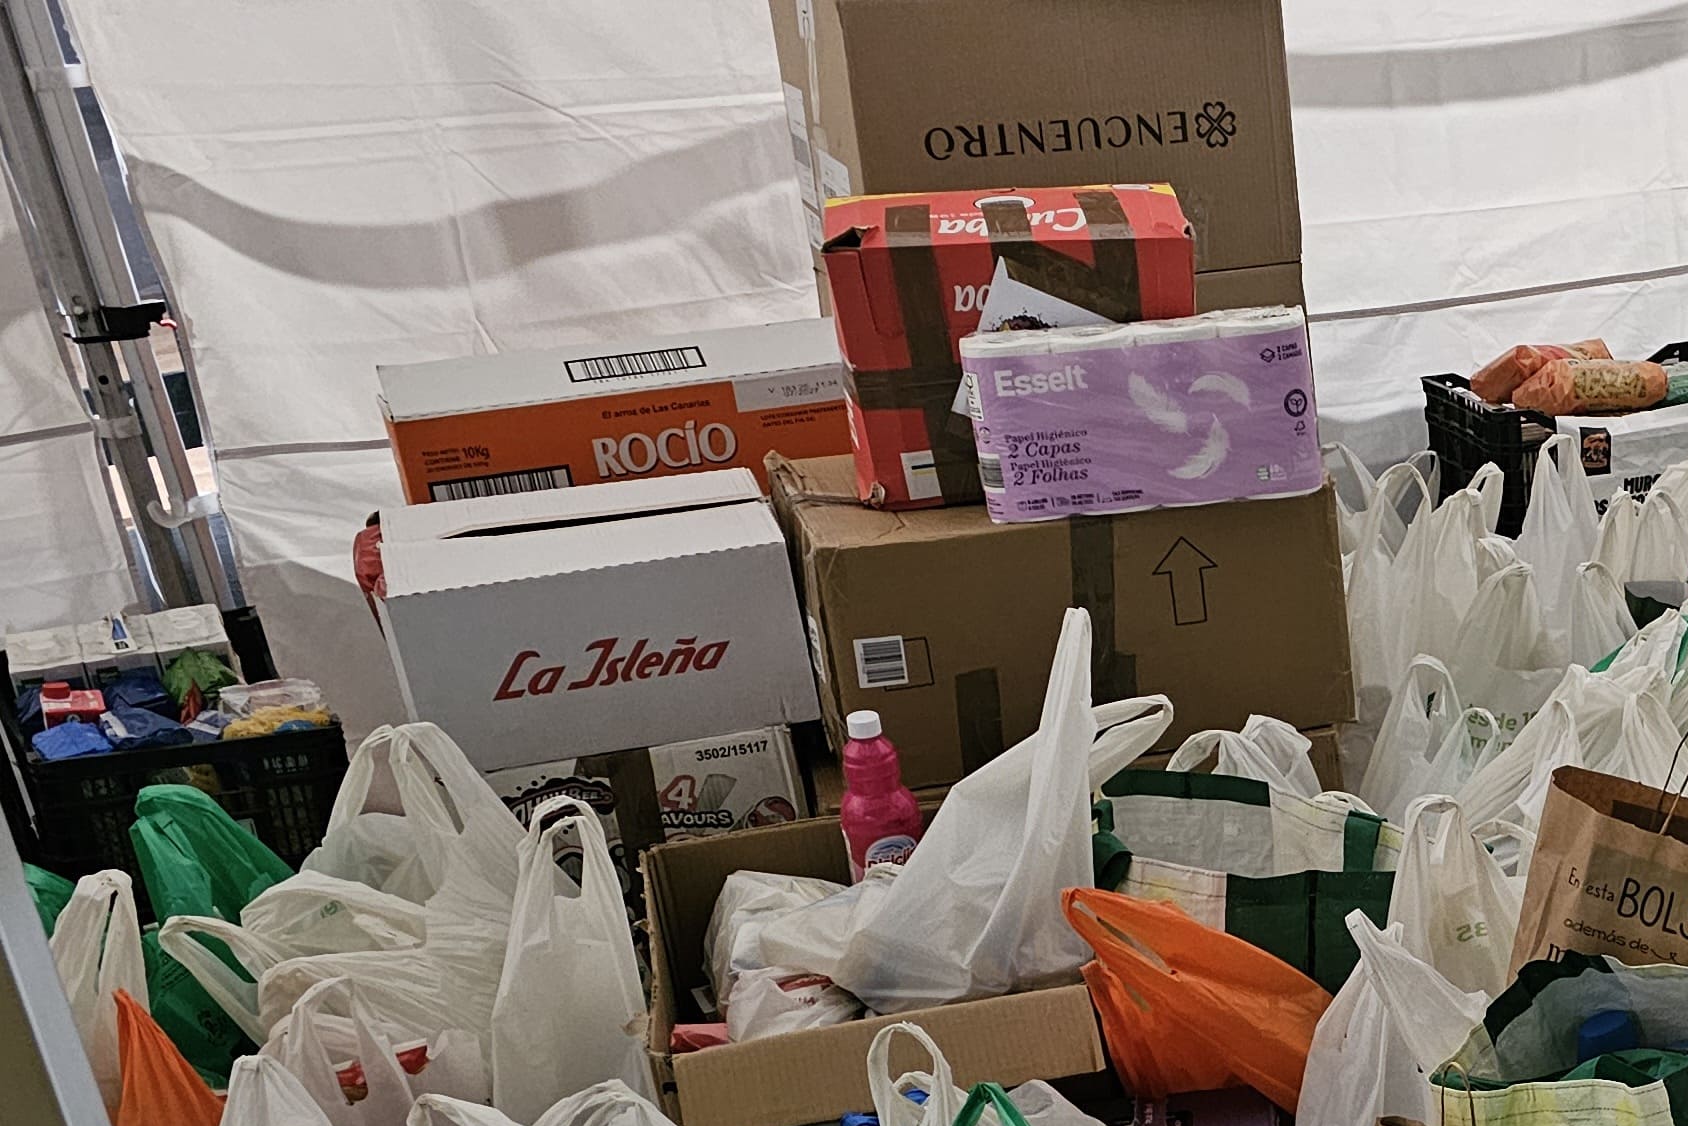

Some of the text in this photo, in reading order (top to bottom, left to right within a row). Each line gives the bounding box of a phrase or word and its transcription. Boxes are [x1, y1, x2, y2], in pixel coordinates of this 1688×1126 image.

[925, 111, 1189, 160] ENCUENTRO
[994, 365, 1088, 397] Esselt
[602, 399, 711, 420] El arroz de Las Canarias
[592, 420, 737, 478] ROCÍO
[1004, 432, 1035, 444] Papel
[1007, 440, 1081, 458] 2 Capas
[1010, 460, 1040, 474] Papel
[1013, 467, 1089, 486] 2 Folhas
[493, 636, 730, 701] La Isleña
[695, 740, 768, 761] 3502/15117
[667, 784, 693, 809] 4
[1568, 866, 1580, 889] En
[1585, 883, 1615, 902] esta
[1563, 917, 1650, 954] además de
